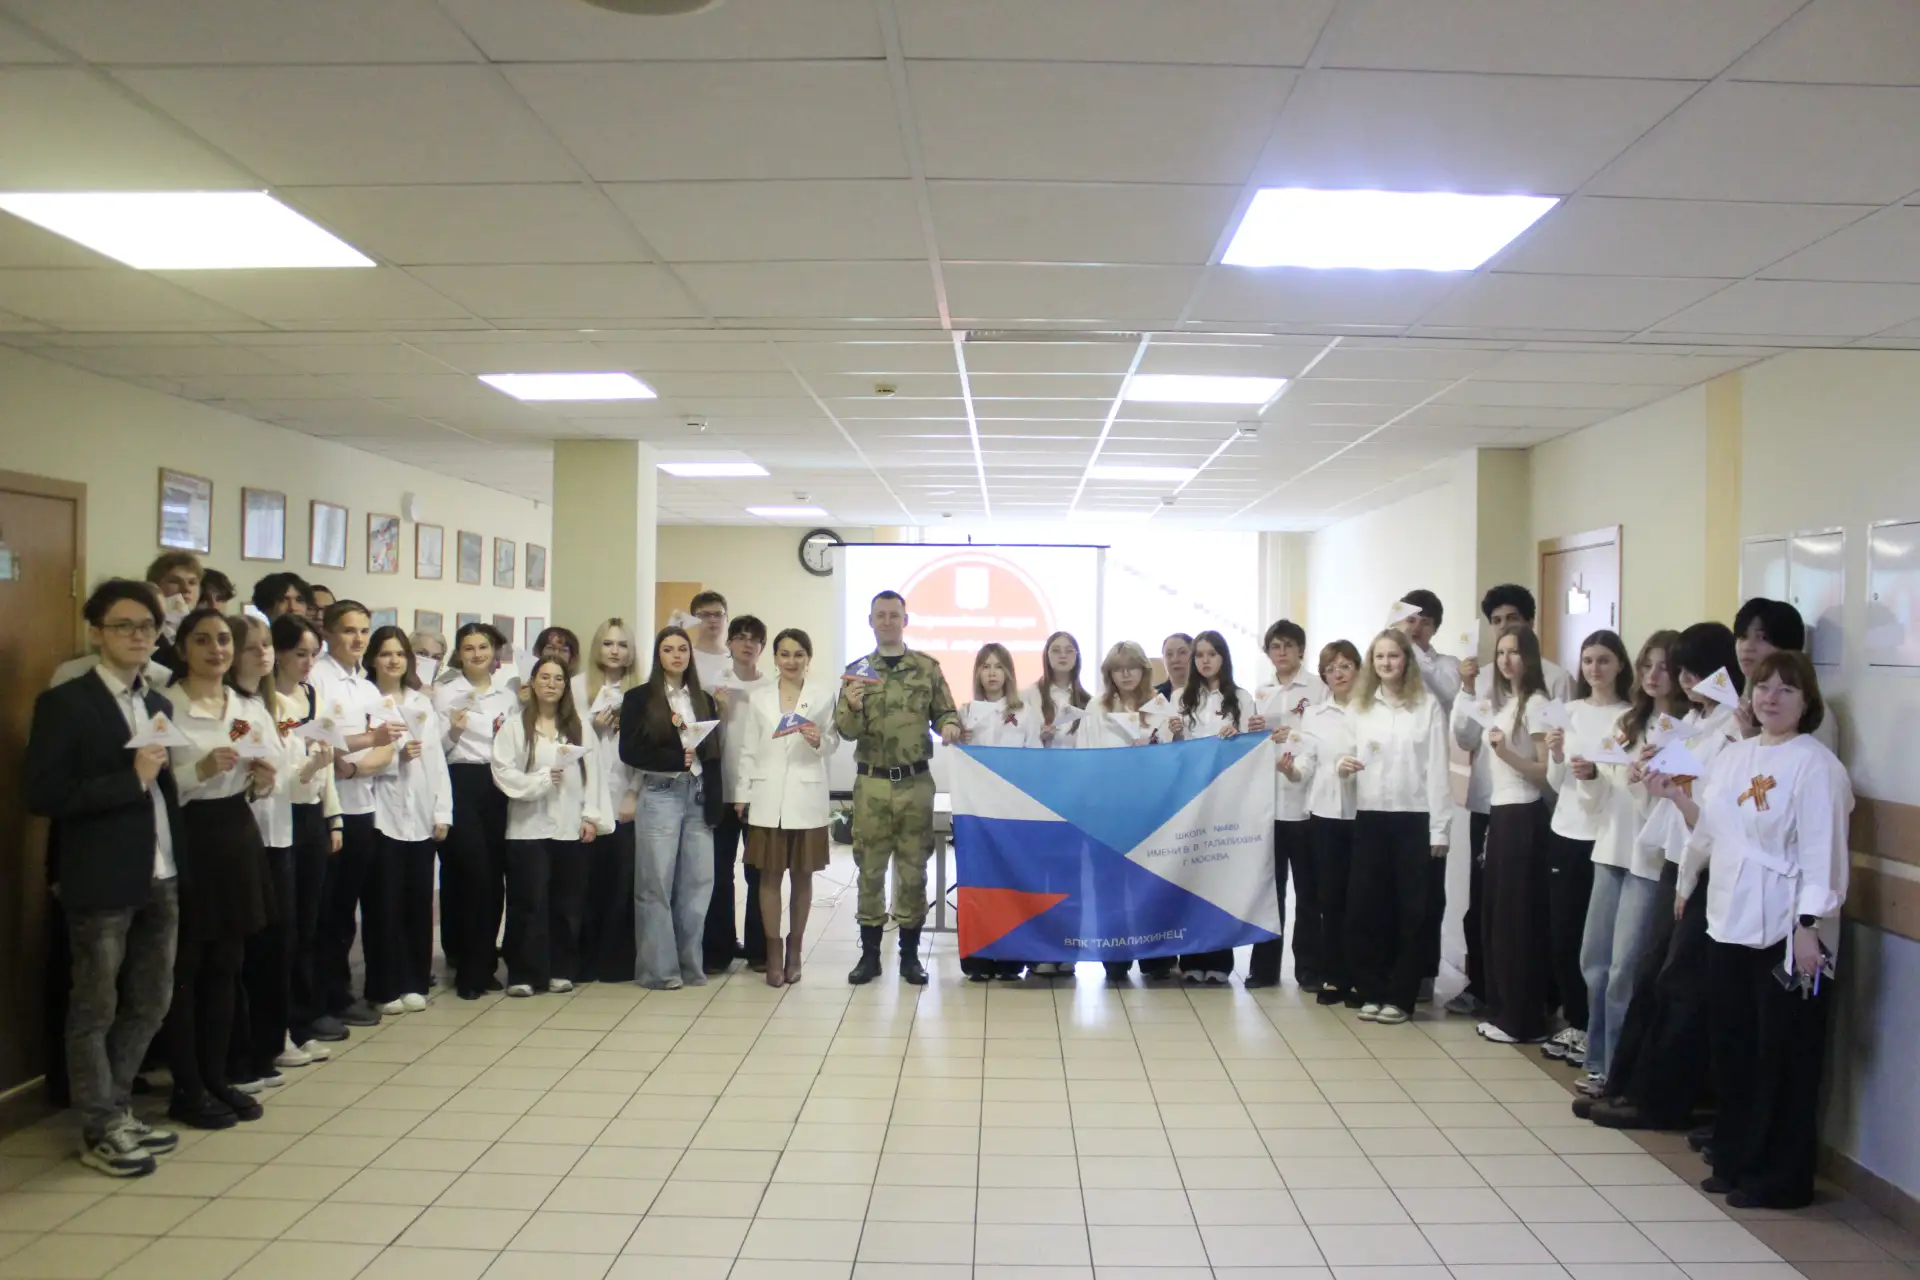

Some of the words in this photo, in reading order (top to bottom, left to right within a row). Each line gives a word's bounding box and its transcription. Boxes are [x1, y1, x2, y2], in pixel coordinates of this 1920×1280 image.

[1175, 828, 1206, 840] ШКОЛА
[1147, 847, 1181, 858] ИМЕНИ
[1204, 834, 1262, 849] ТАЛАЛИХИНА
[1191, 852, 1229, 864] МОСКВА
[1064, 938, 1088, 948] ВПК
[1091, 928, 1187, 948] "ТАЛАЛИХИНЕЦ"
